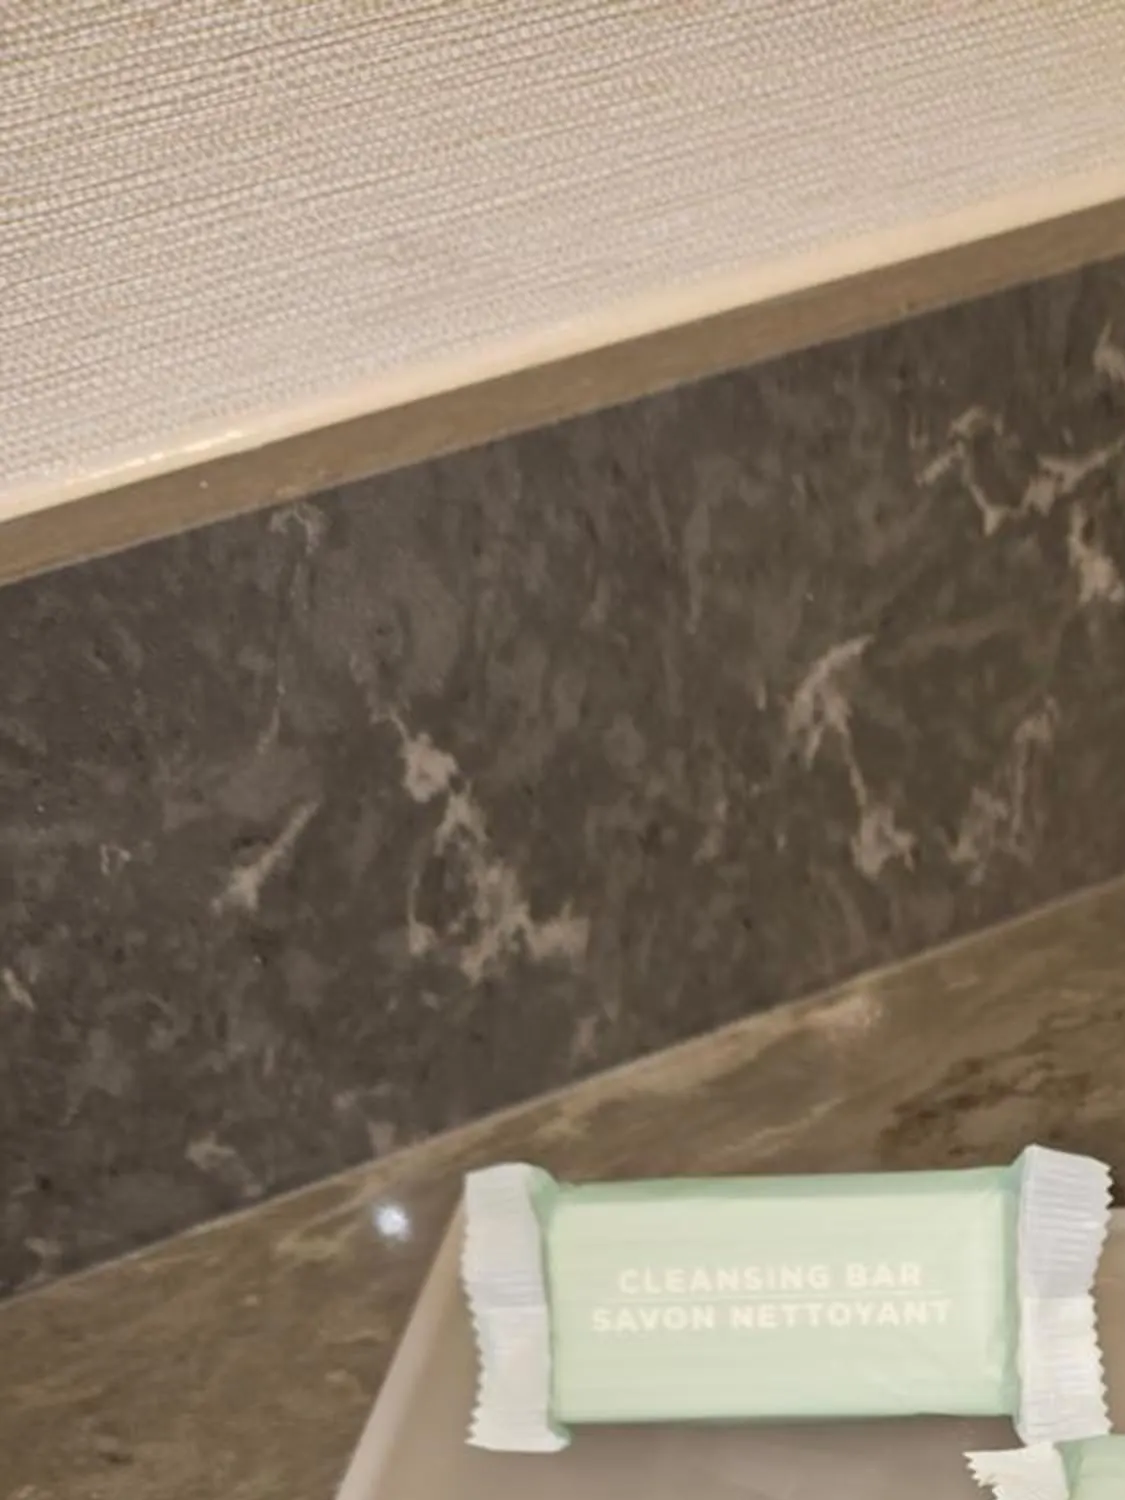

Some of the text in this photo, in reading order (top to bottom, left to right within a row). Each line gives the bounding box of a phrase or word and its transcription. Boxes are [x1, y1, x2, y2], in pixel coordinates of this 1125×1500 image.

[619, 1262, 923, 1295] CLEANSING BAR
[592, 1299, 953, 1332] SAVON NETTOYANT
